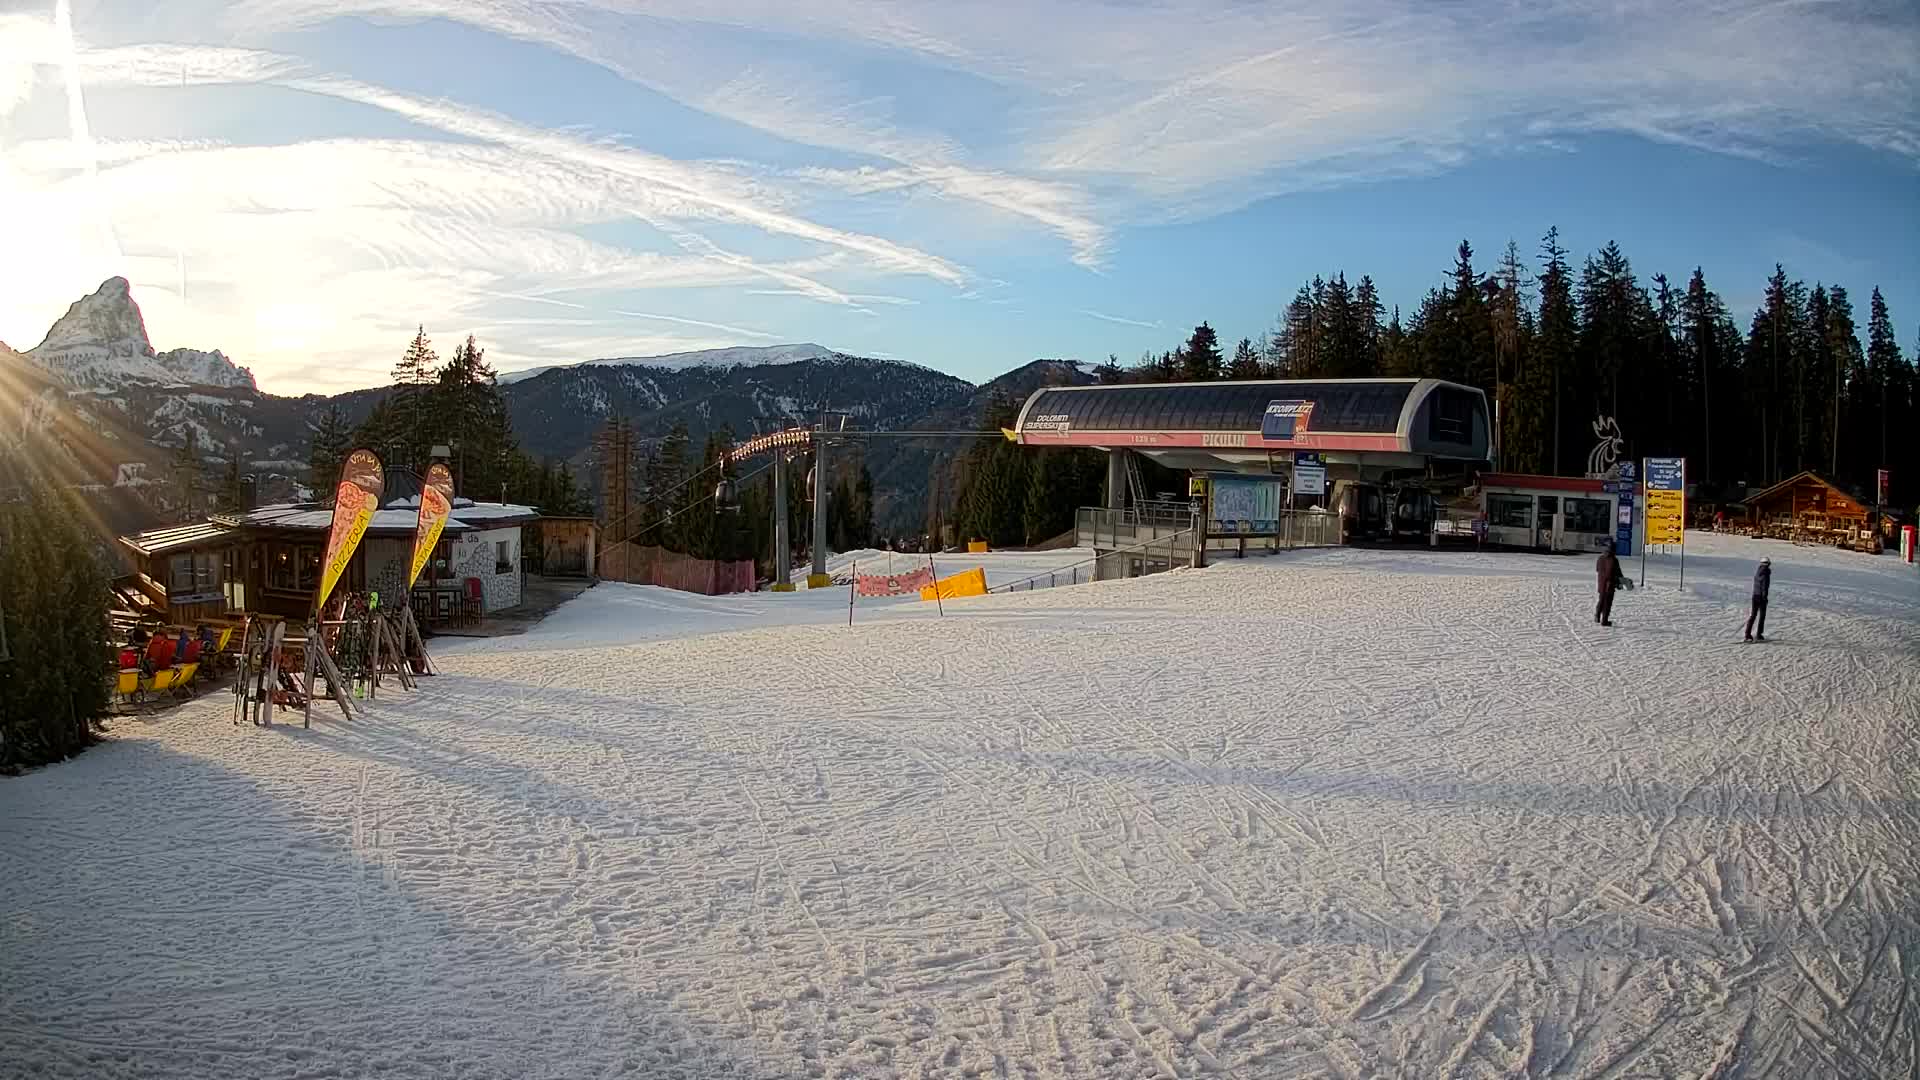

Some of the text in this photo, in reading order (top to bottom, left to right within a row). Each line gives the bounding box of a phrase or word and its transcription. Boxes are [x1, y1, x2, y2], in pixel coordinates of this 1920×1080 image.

[1266, 405, 1313, 413] KRONPLATZ
[1025, 422, 1059, 430] SUPERSKI
[1202, 433, 1245, 447] PICULIN
[332, 514, 369, 574] PIZZERIA
